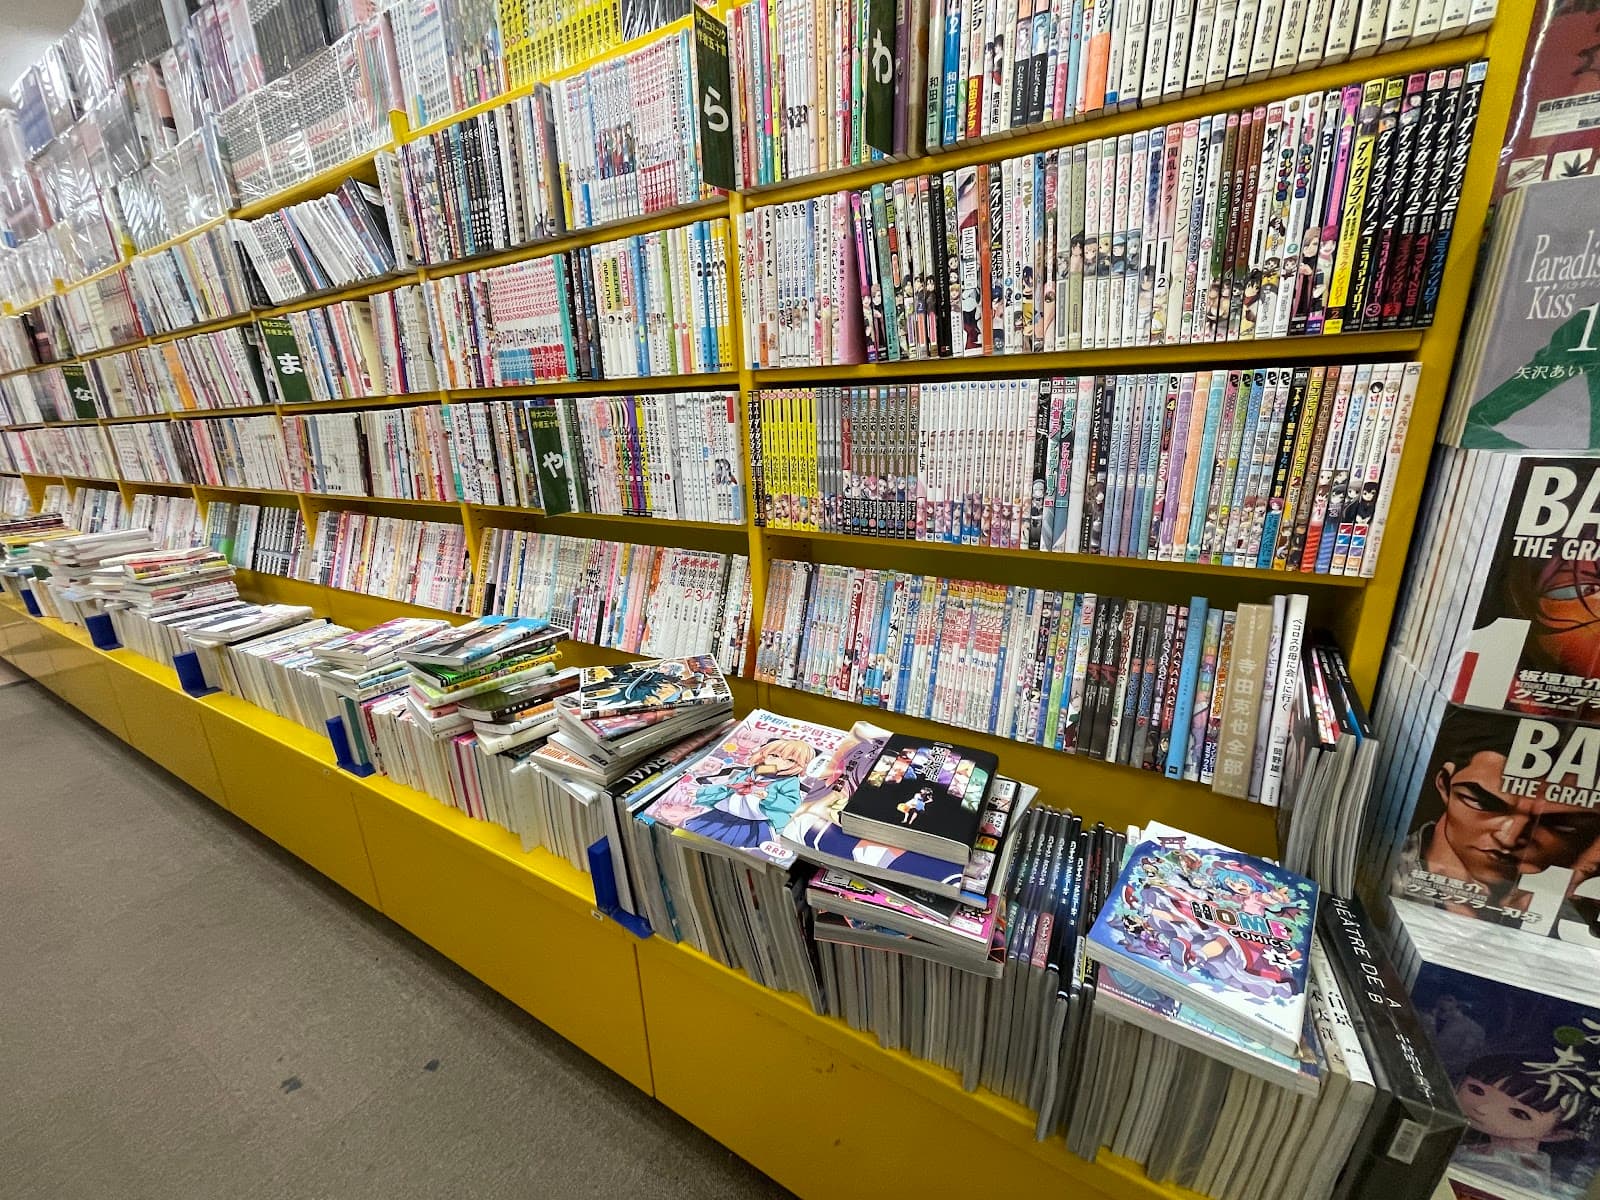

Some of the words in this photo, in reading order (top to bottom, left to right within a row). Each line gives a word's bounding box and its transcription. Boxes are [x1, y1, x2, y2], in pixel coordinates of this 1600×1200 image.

[872, 28, 894, 84] わ
[703, 85, 730, 132] ら
[765, 209, 774, 278] くまのプーさん
[1157, 277, 1166, 288] 2
[1526, 283, 1577, 320] Kiss
[1567, 302, 1600, 352] 1
[276, 352, 304, 375] ま
[1513, 365, 1585, 380] 矢沢あい
[1092, 386, 1104, 440] メイドインアビス
[542, 450, 564, 479] や
[1353, 467, 1362, 480] 4
[1369, 466, 1378, 480] 5
[1513, 537, 1553, 559] THE
[695, 589, 703, 602] 3
[1223, 658, 1258, 776] 寺田克也全部
[1503, 718, 1600, 791] BA
[1501, 775, 1542, 799] THE
[764, 844, 788, 858] RRR
[1406, 883, 1545, 924] グラップラー刃牙
[1189, 900, 1294, 941] HOME
[1228, 928, 1292, 951] COMICS
